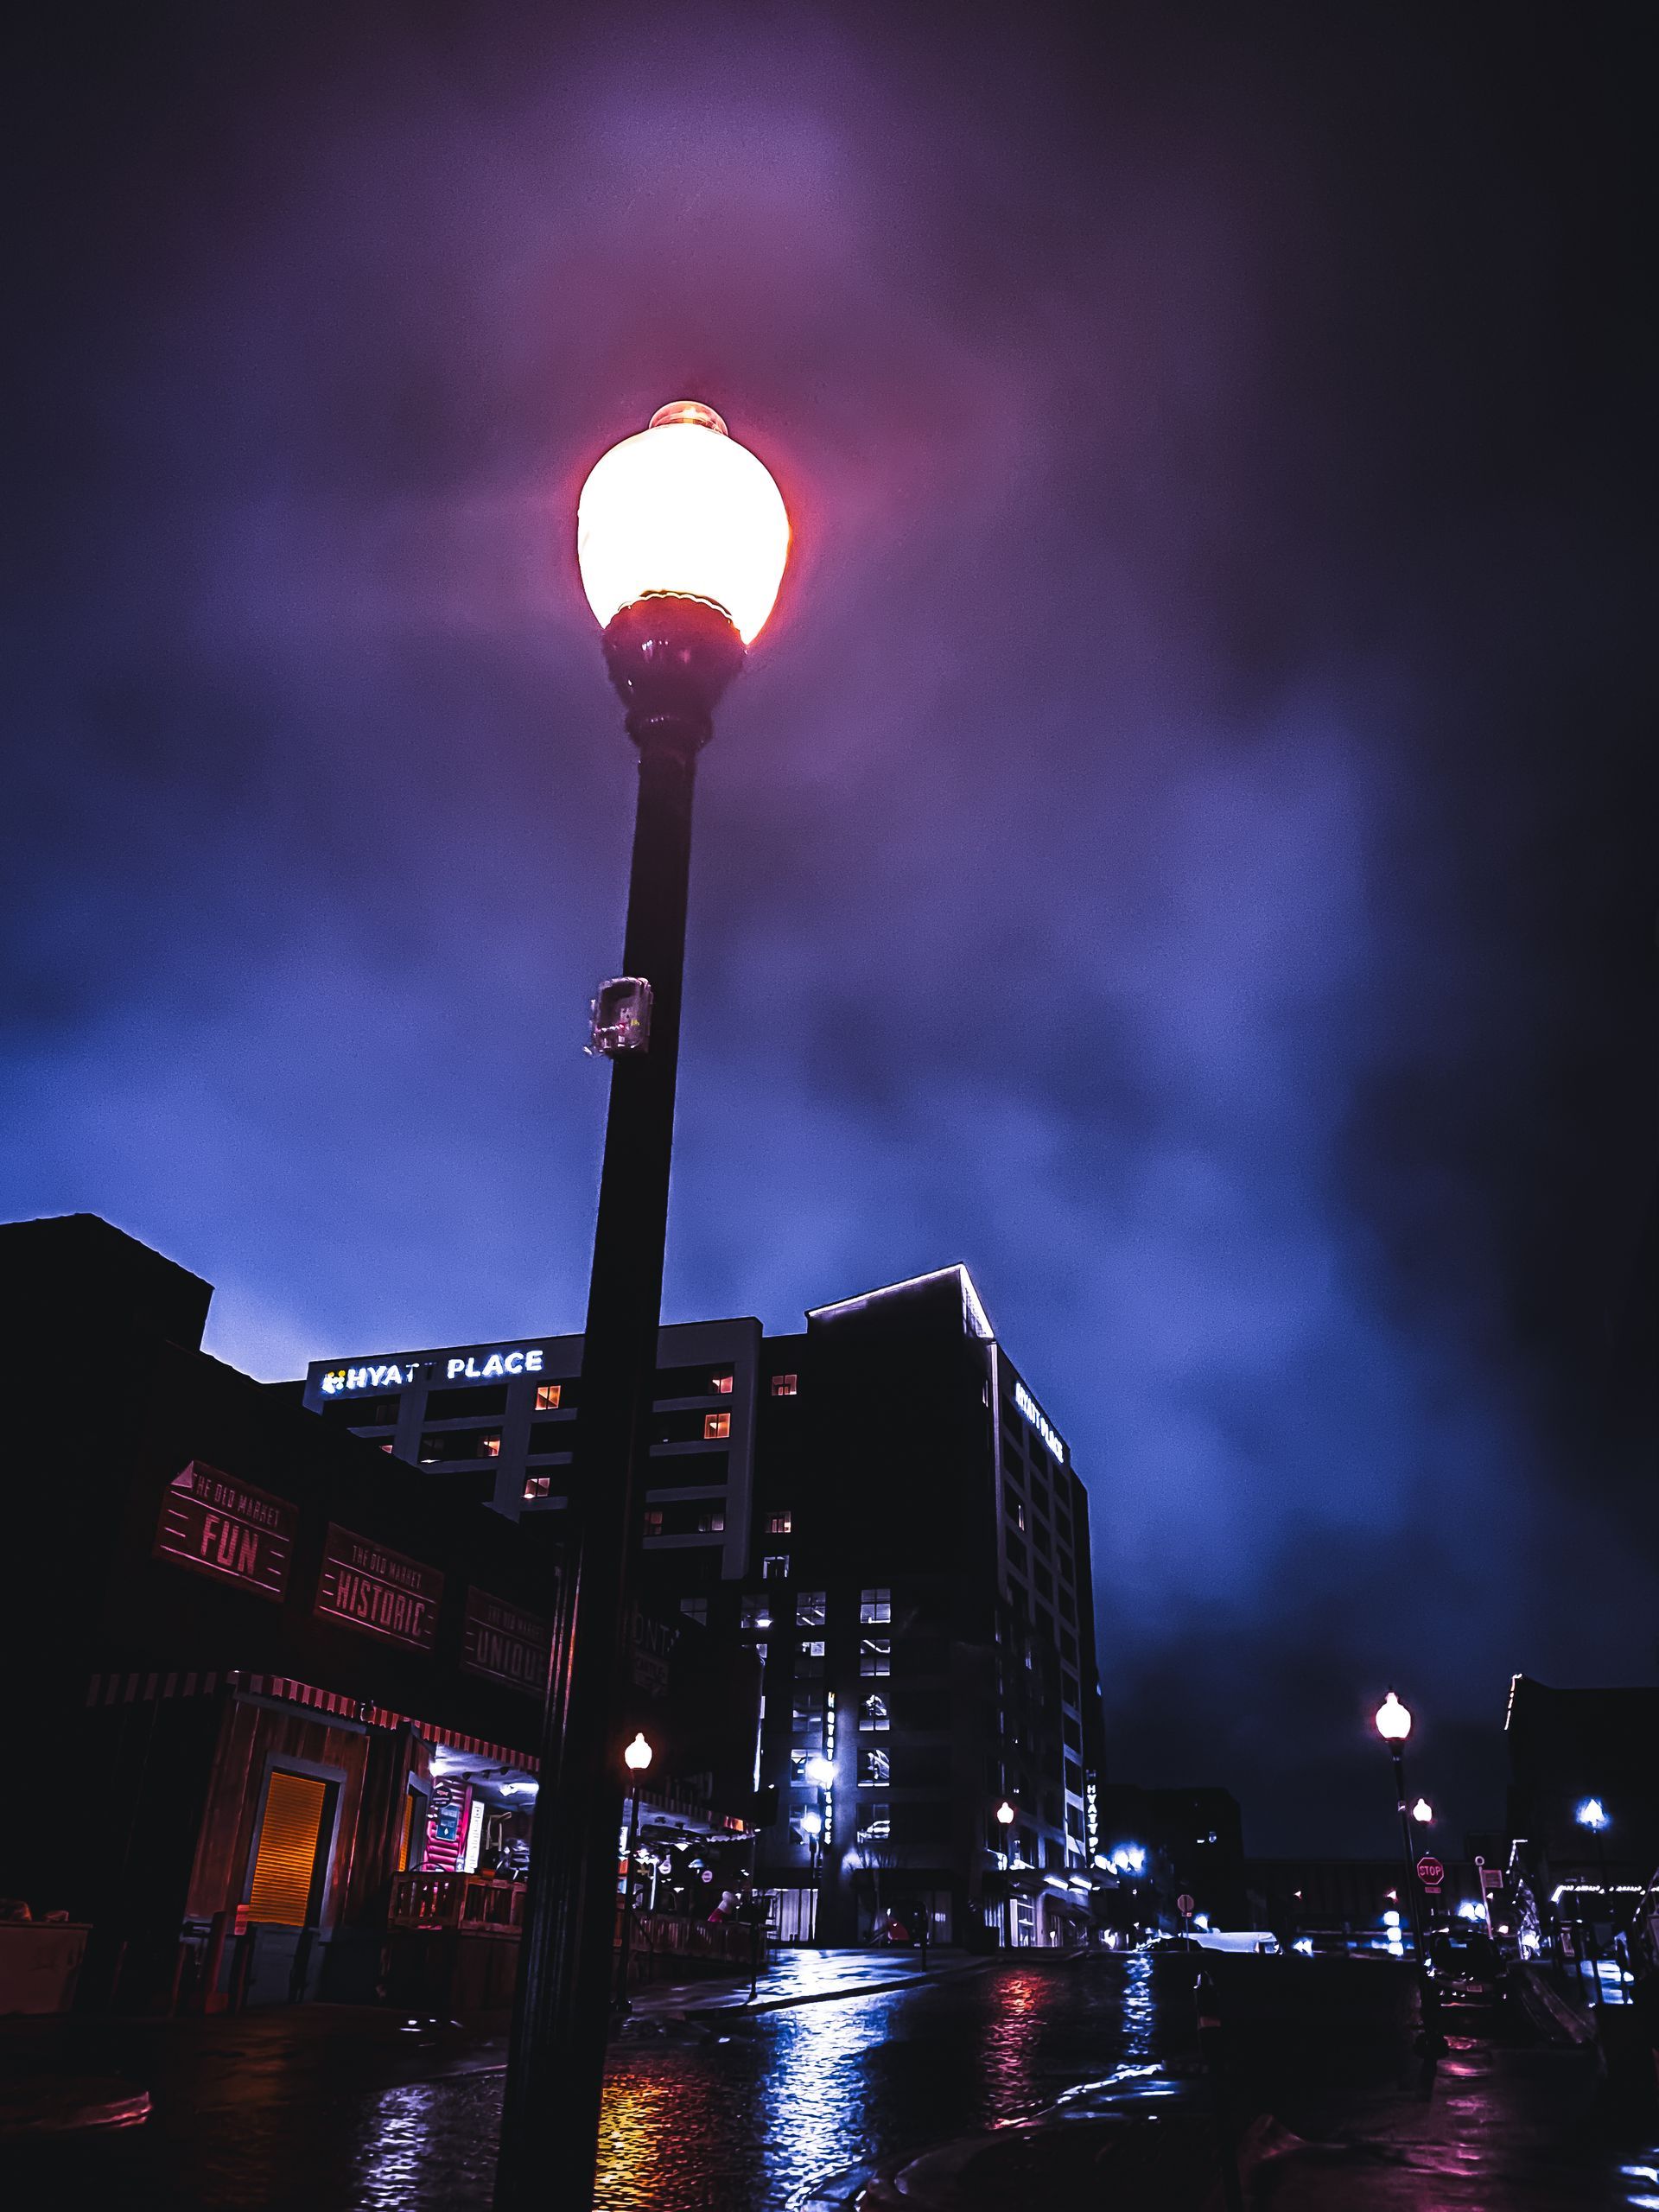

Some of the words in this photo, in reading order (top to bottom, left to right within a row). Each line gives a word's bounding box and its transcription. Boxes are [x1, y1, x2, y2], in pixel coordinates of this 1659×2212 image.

[447, 1350, 543, 1379] PLACE
[214, 1483, 236, 1508] OLD
[238, 1494, 280, 1527] MARKET
[200, 1512, 258, 1575] FUN
[353, 1545, 369, 1567] THE
[370, 1554, 387, 1574] OLD
[390, 1560, 423, 1590] MARKET
[336, 1570, 425, 1637] HISTORIC
[1087, 1784, 1098, 1835] HYATT
[1420, 1866, 1441, 1877] STOP
